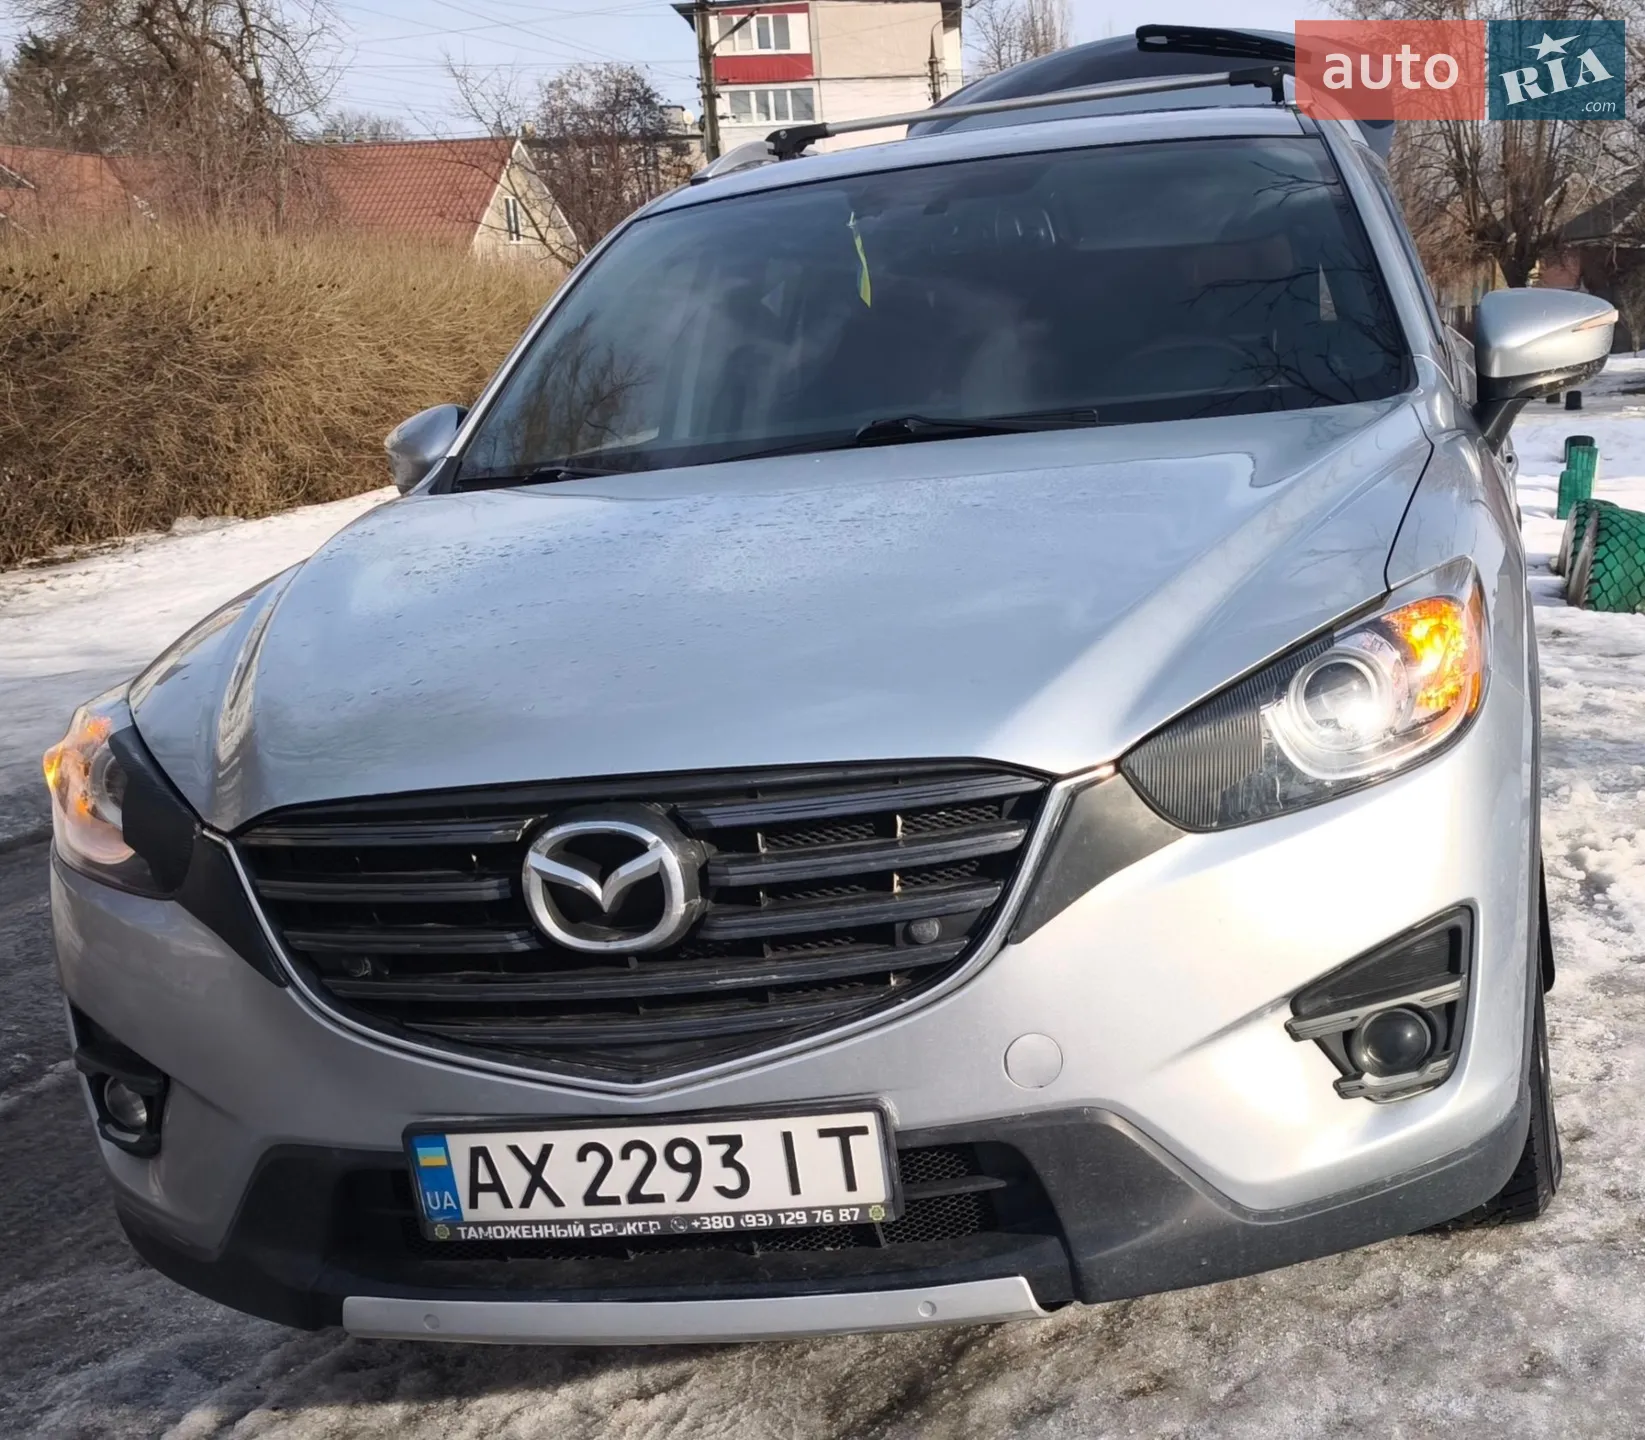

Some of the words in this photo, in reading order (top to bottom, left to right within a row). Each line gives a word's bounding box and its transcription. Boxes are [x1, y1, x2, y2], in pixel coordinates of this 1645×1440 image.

[468, 1143, 566, 1209] AX
[576, 1134, 751, 1206] 2293
[426, 1191, 458, 1210] UA
[457, 1221, 585, 1240] ТАМОЖЕННЫЙ
[691, 1215, 735, 1230] +380
[740, 1212, 774, 1228] (93)
[778, 1211, 807, 1225] 129
[811, 1209, 834, 1223] 76
[839, 1208, 860, 1221] 87
